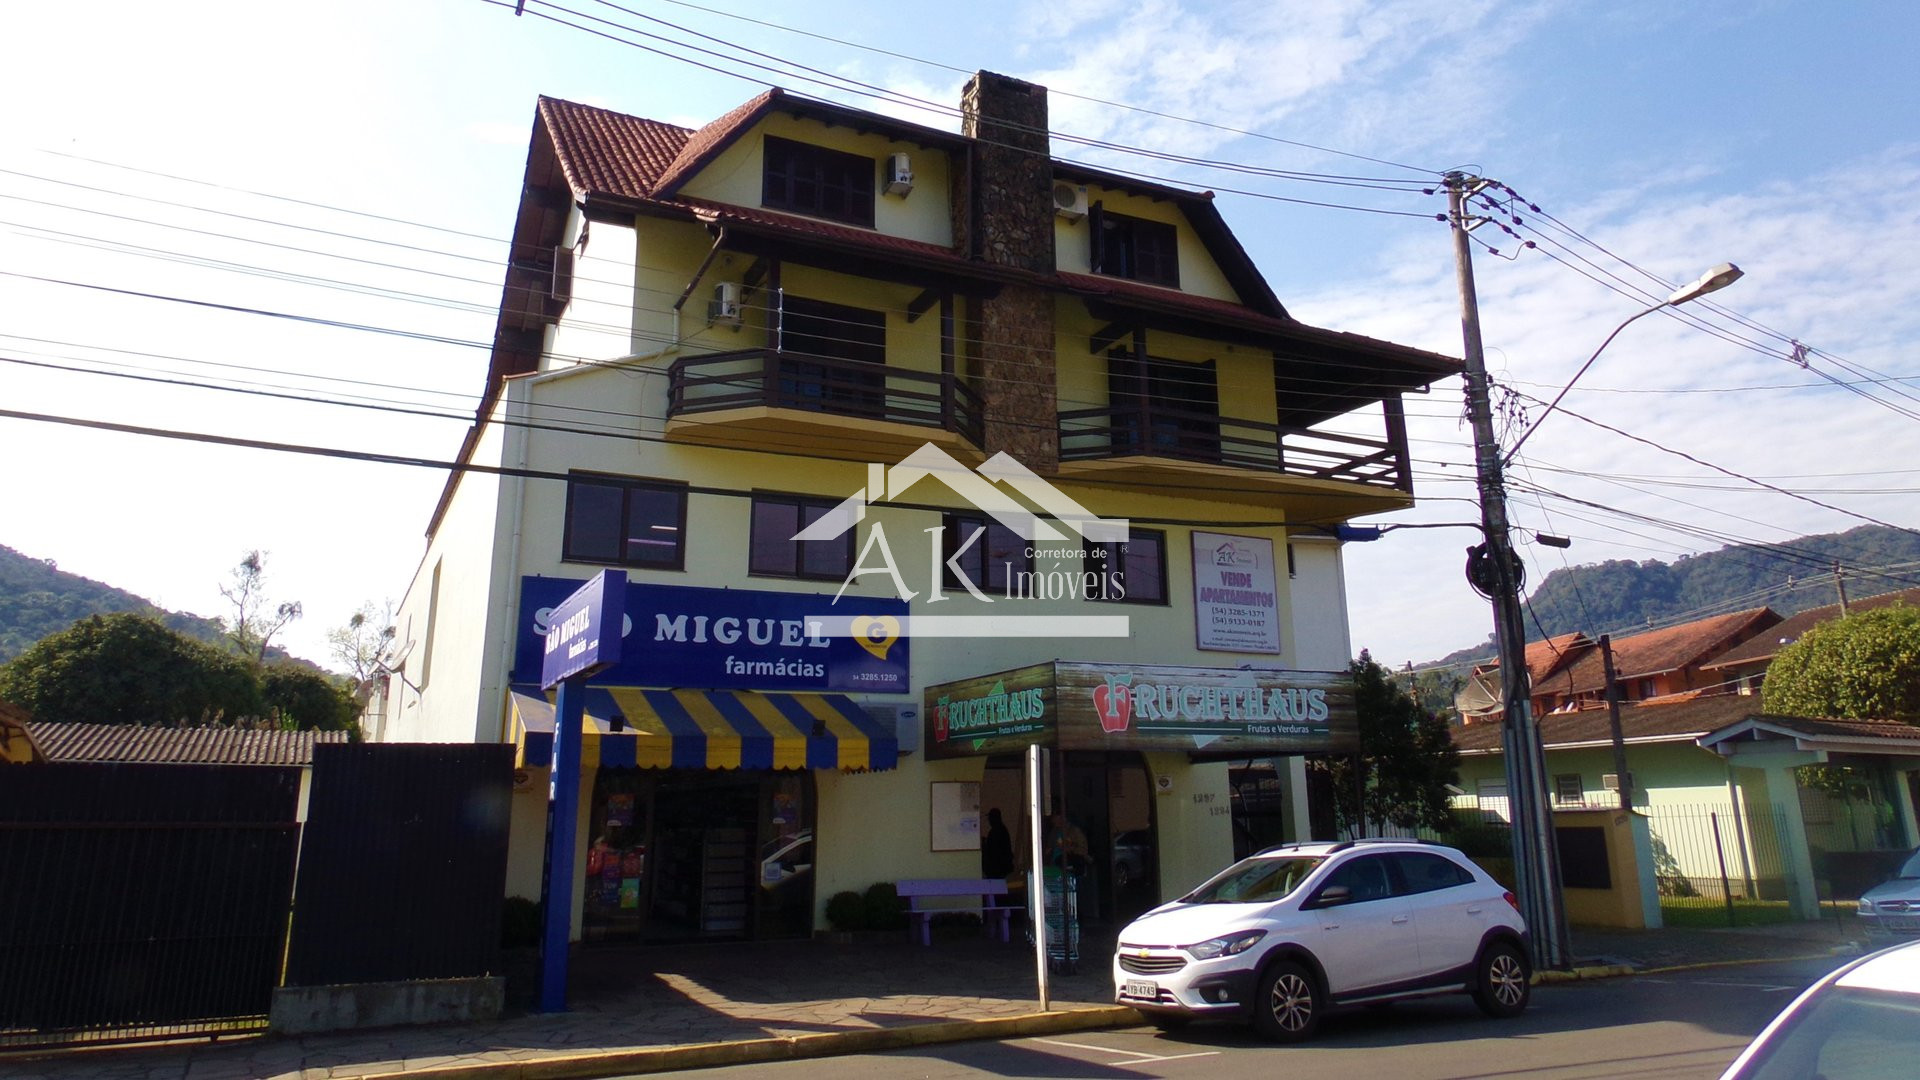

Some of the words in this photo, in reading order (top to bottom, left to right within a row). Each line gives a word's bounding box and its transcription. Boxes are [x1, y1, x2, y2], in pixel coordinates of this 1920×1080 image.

[1220, 571, 1252, 588] VENDE
[1212, 607, 1227, 616] (54)
[1228, 608, 1265, 618] 3285-1371
[1212, 617, 1227, 625] (54)
[560, 605, 589, 645] MIGUEL
[654, 613, 830, 648] MIGUEL
[725, 655, 824, 677] farmácias
[860, 673, 897, 681] 3285.1250
[1103, 672, 1329, 722] FRUCHTHAUS
[938, 688, 1044, 731] FRUCHTHAUS
[1247, 724, 1270, 733] Frutas
[1277, 725, 1309, 734] Verduras
